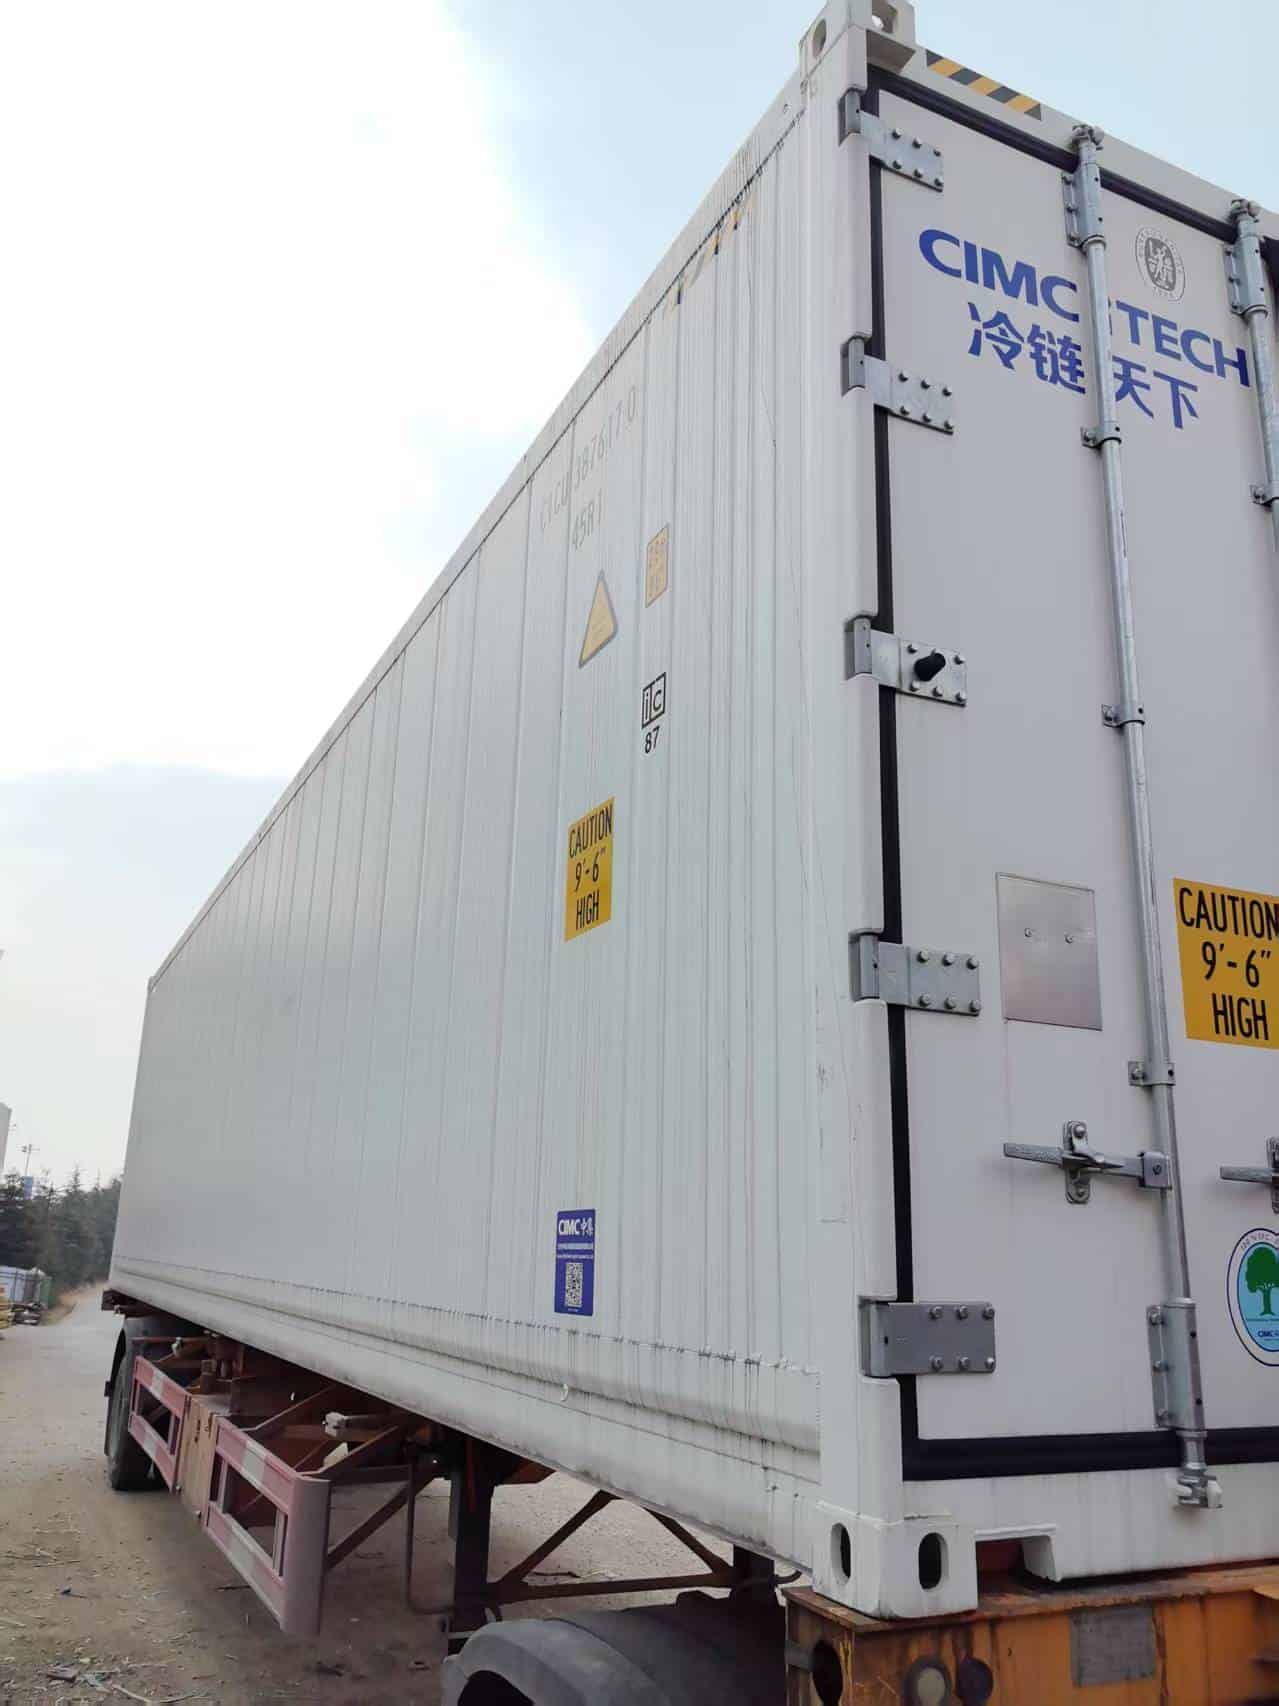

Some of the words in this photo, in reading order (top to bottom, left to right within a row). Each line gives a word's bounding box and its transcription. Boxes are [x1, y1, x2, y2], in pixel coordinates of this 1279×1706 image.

[919, 229, 1080, 323] CIMC
[645, 726, 660, 754] 87
[569, 803, 613, 859] CAUTION
[576, 888, 600, 931] HIGH
[1179, 887, 1279, 941] CAUTION
[1211, 992, 1269, 1041] HIGH
